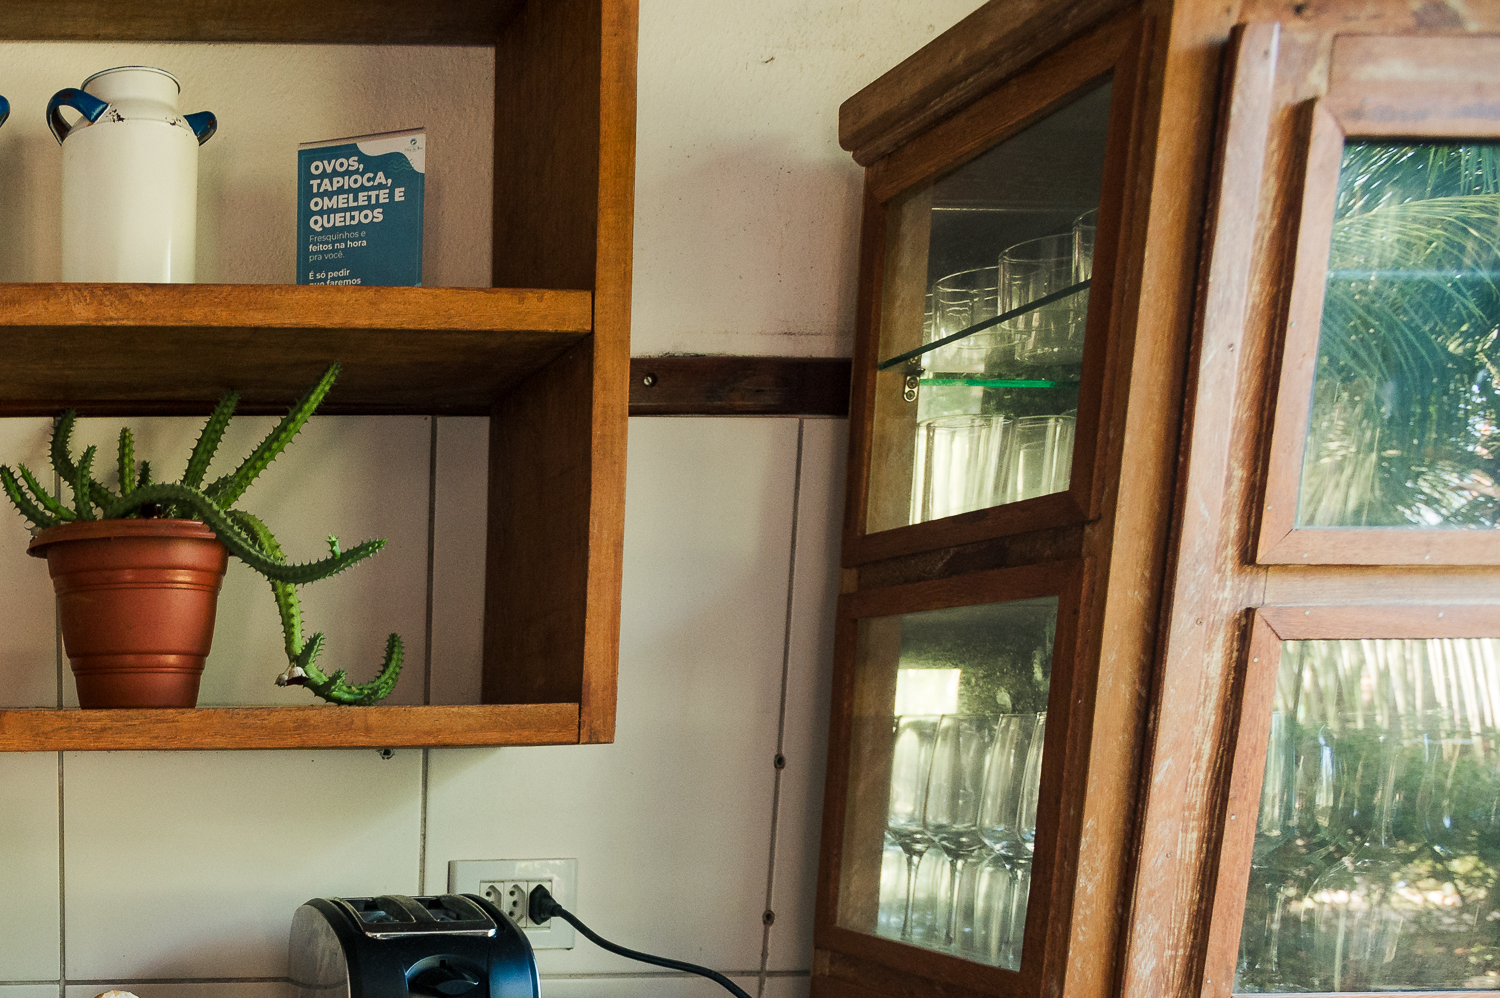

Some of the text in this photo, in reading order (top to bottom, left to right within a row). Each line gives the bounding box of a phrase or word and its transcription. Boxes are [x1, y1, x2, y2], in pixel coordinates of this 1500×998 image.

[310, 156, 364, 175] OVOS,
[309, 171, 392, 193] TAPIOCA,
[309, 187, 405, 211] OMELETE E
[309, 208, 384, 231] QUEIJOS
[309, 230, 366, 243] Fresquinhos e
[309, 241, 333, 252] feitos
[347, 239, 367, 248] hora
[309, 254, 322, 263] pra
[309, 268, 350, 280] É só pedir
